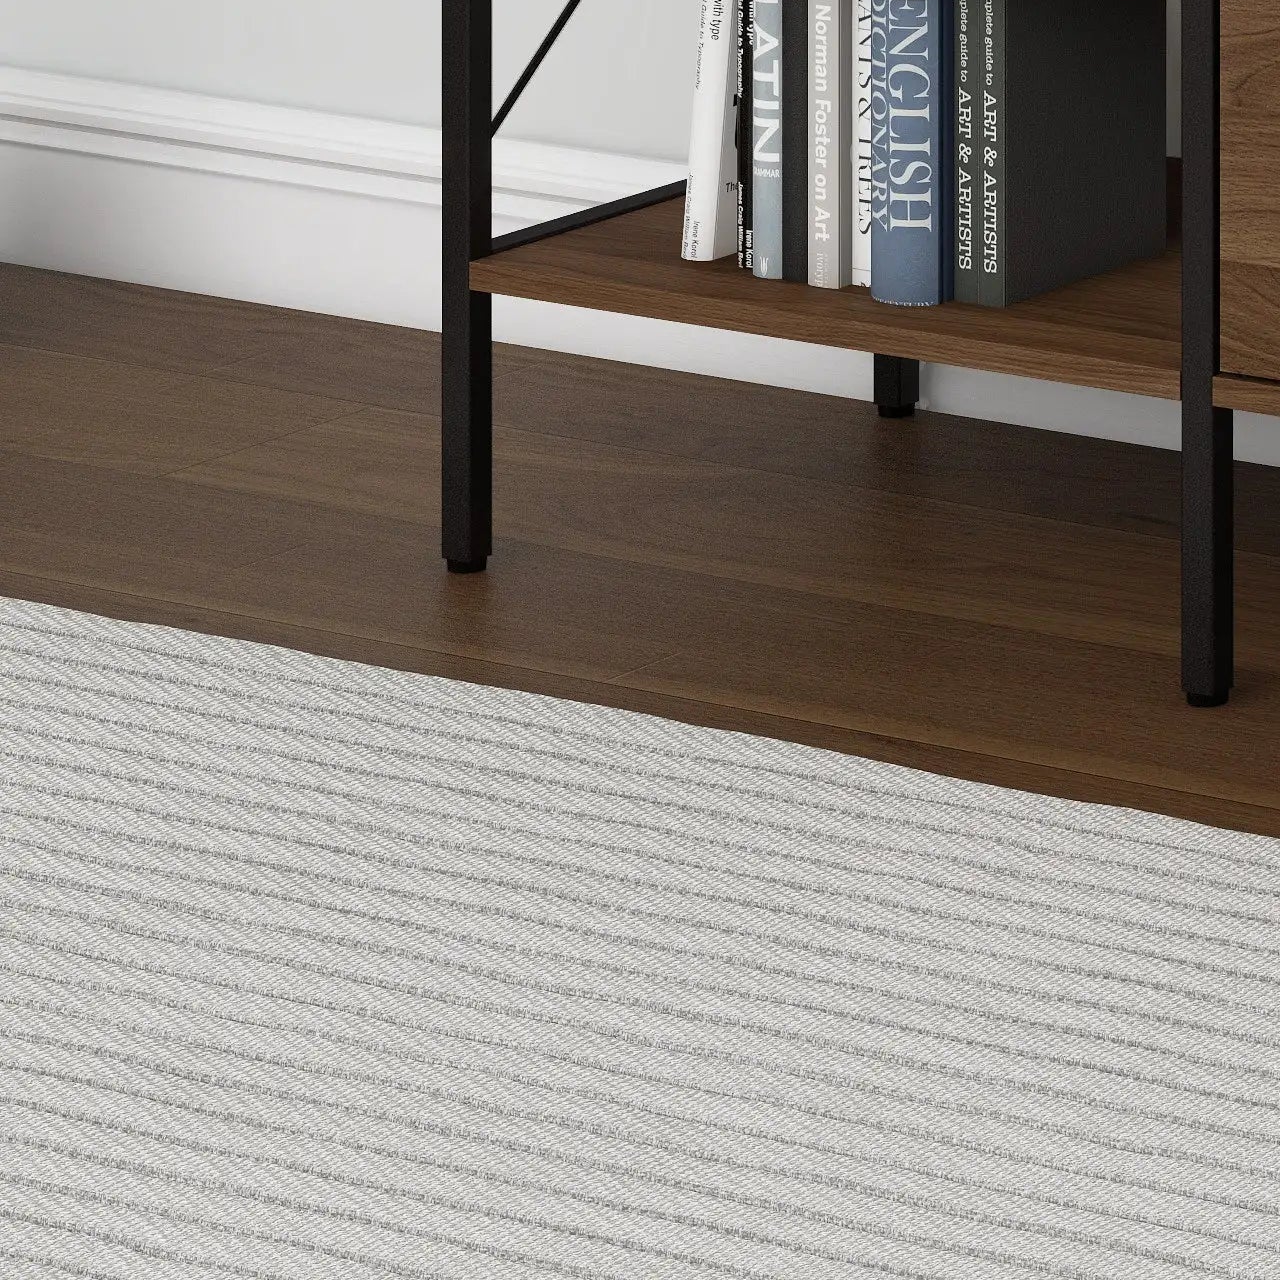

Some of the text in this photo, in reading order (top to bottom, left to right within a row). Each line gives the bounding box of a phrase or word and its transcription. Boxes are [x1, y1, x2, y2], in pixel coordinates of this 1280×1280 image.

[710, 20, 722, 41] type
[815, 4, 832, 92] Norman
[959, 33, 968, 68] guide
[984, 37, 993, 71] guide
[960, 69, 968, 83] to
[985, 72, 993, 86] to
[958, 86, 972, 139] ART
[983, 90, 997, 142] ART
[815, 99, 831, 168] Foster
[958, 143, 972, 164] &
[983, 146, 997, 167] &
[815, 173, 827, 200] on
[814, 206, 831, 242] Art
[958, 167, 972, 270] ARTISTS
[983, 170, 997, 273] ARTISTS
[745, 248, 753, 268] Korol
